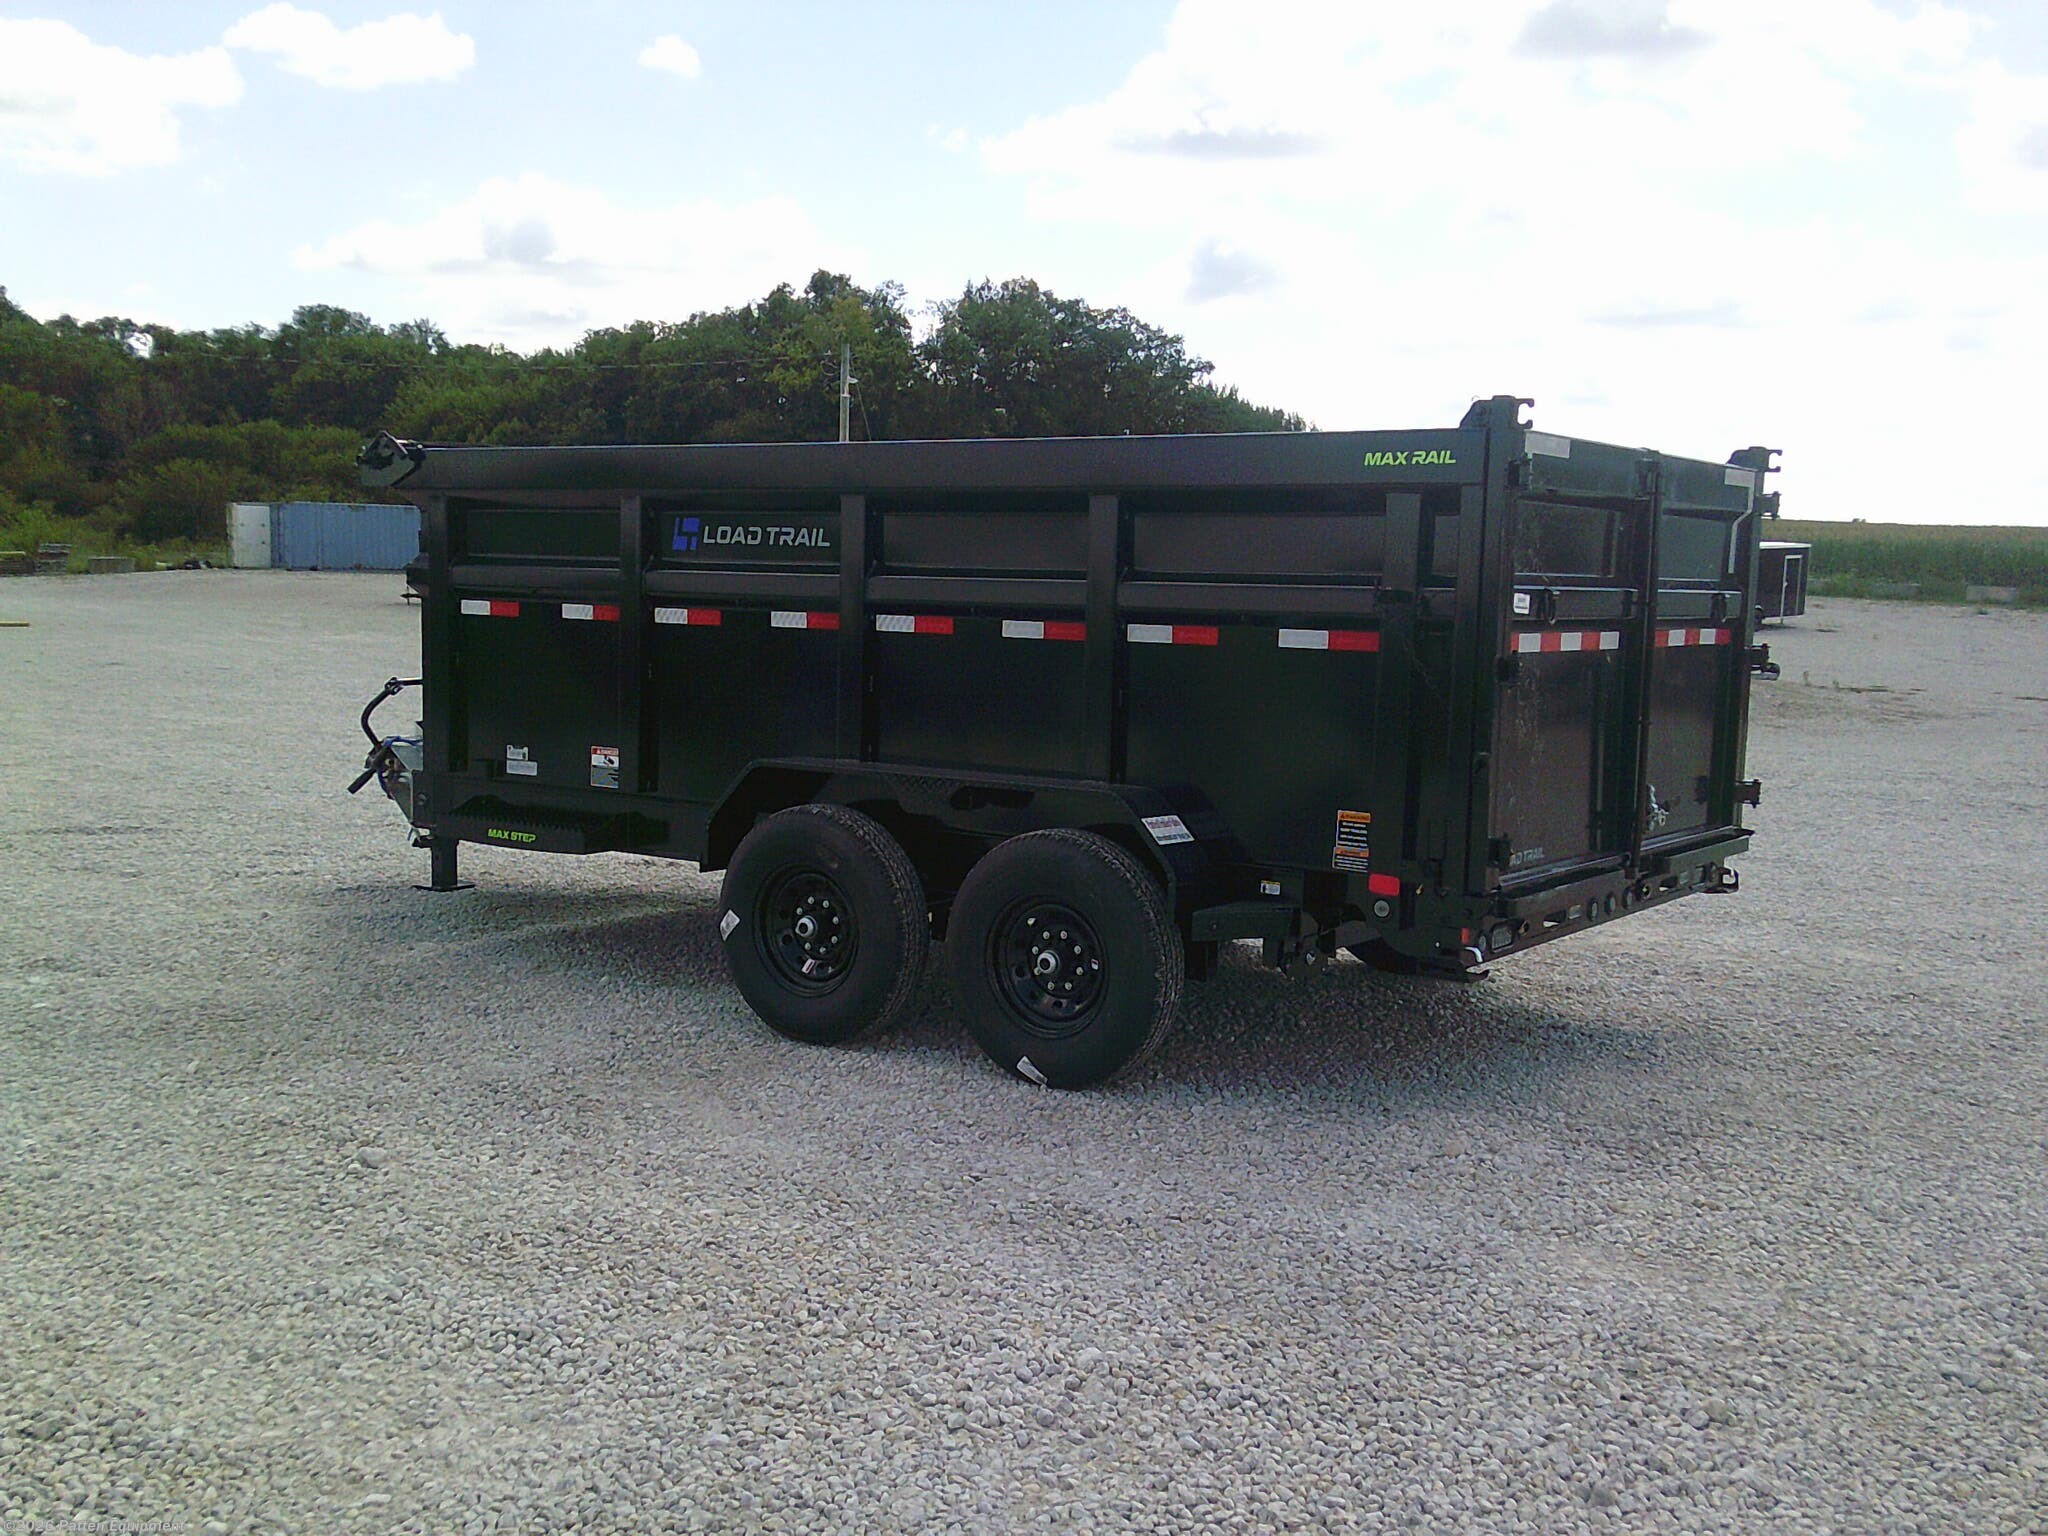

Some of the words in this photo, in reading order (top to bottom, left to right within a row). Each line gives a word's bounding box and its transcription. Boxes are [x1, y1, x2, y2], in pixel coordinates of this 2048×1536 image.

[1364, 452, 1409, 466] MAX
[1411, 450, 1457, 465] RAIL
[703, 525, 763, 546] LOAD
[766, 526, 831, 547] TRAIL
[487, 828, 510, 840] MAX
[510, 831, 537, 843] STEP
